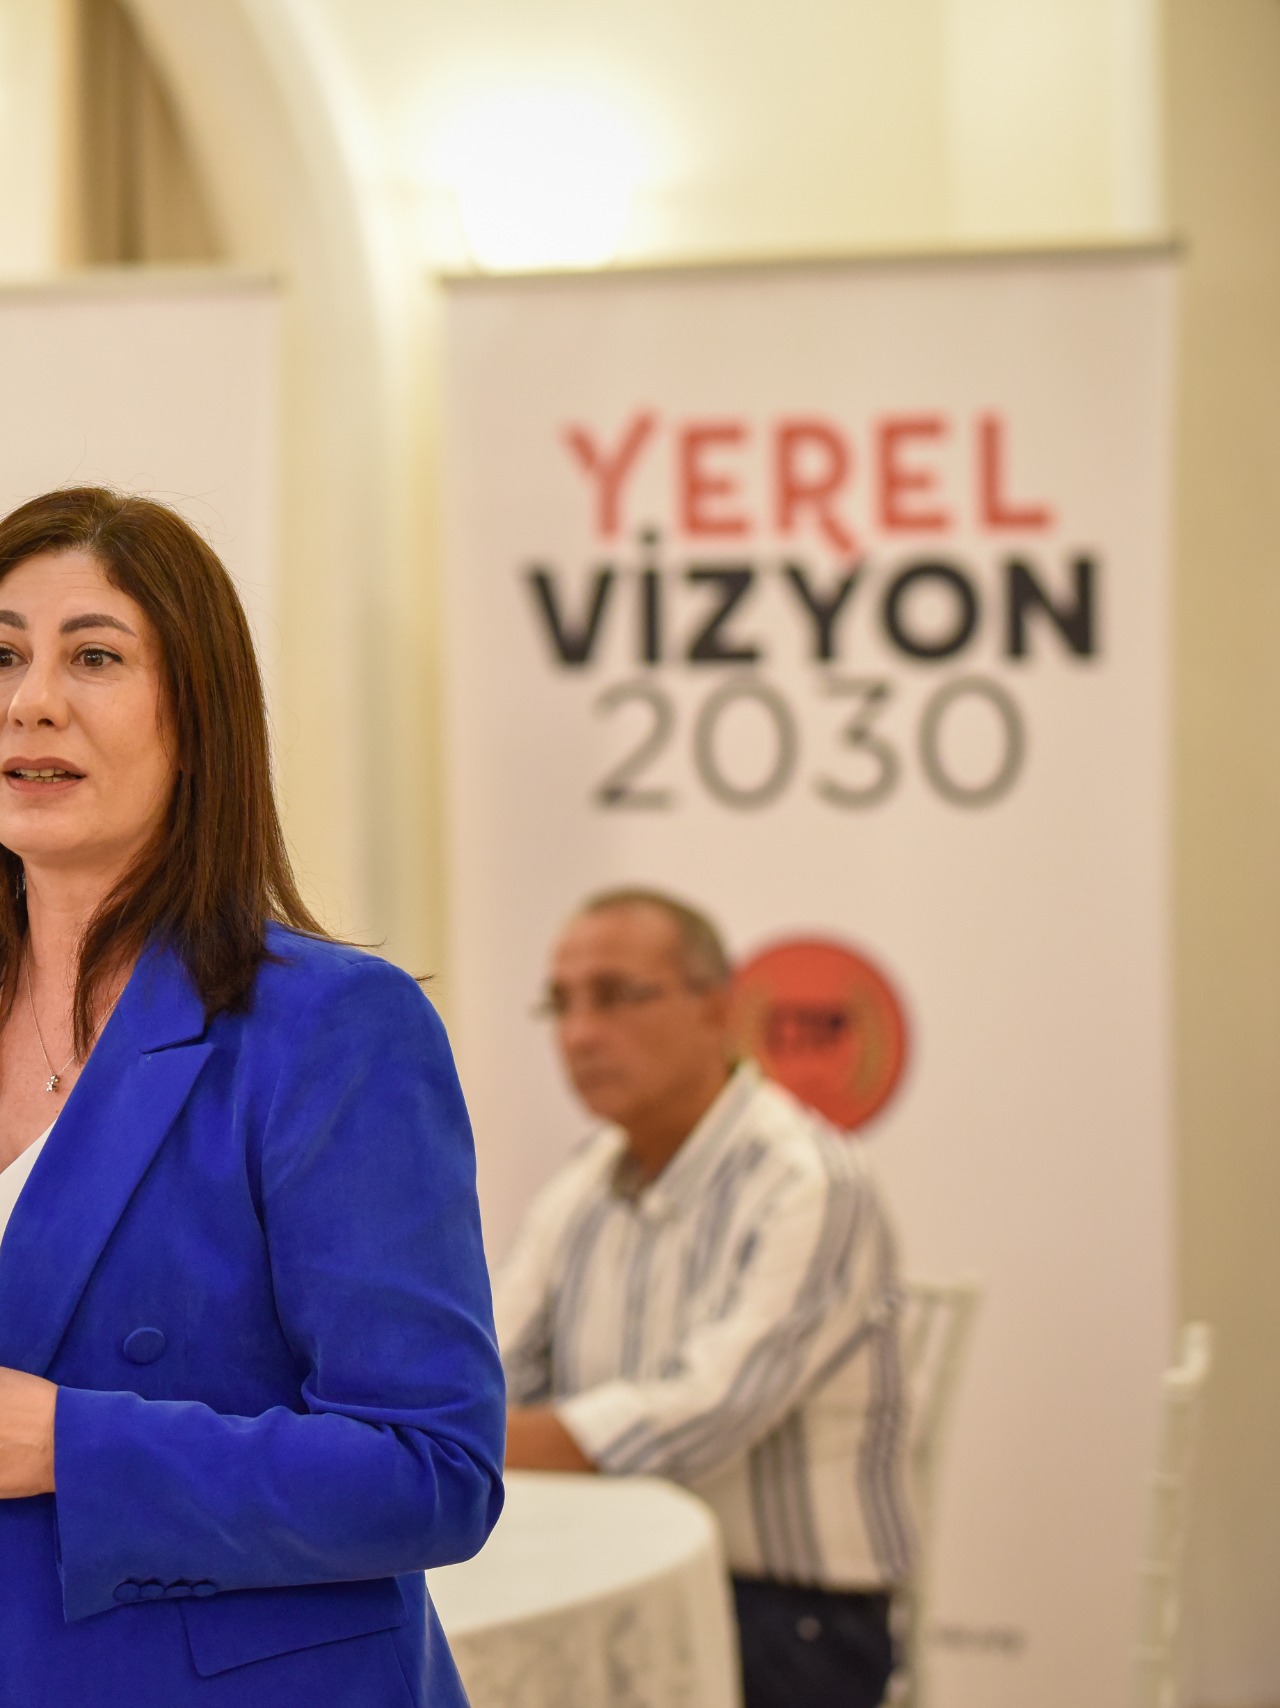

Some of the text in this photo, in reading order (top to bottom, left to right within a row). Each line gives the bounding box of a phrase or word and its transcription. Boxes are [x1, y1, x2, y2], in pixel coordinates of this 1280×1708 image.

[563, 409, 1058, 556] YEREL
[527, 526, 1101, 667] VİZYON
[593, 675, 1026, 812] 2030
